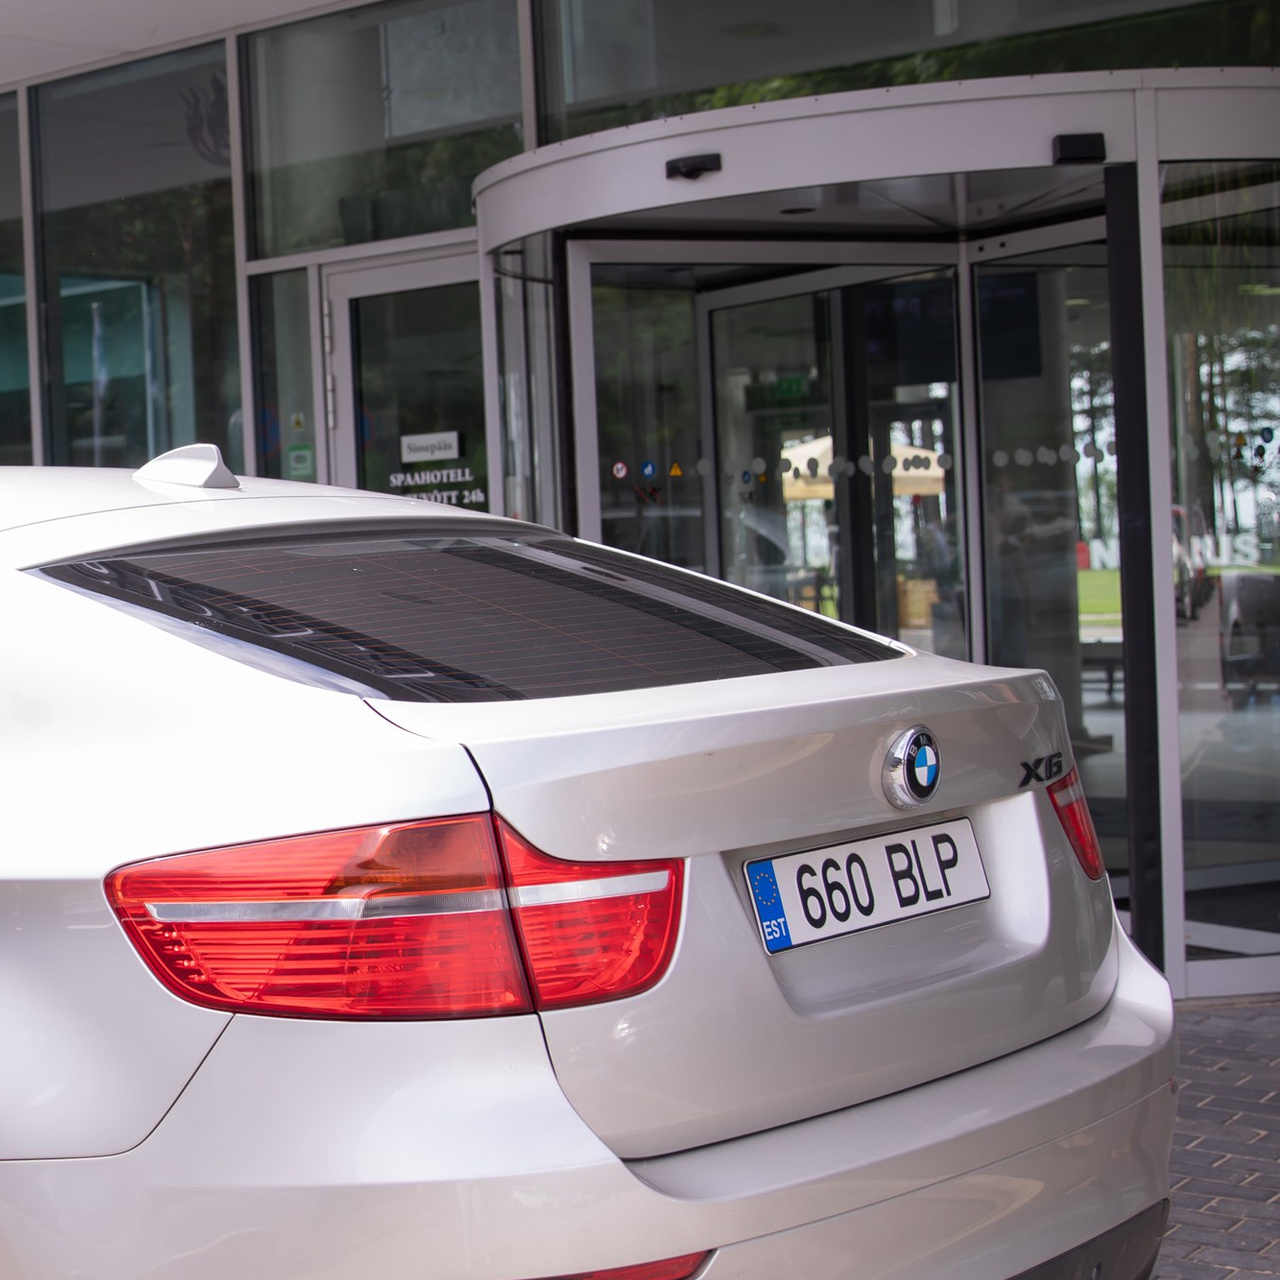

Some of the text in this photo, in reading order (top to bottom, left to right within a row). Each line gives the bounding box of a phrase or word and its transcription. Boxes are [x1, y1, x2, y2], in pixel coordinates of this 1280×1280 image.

[389, 467, 474, 487] SPAAHOTELL
[462, 487, 486, 504] 24h
[1017, 751, 1063, 789] X6
[795, 832, 959, 930] 660 BLP
[762, 917, 789, 941] EST
